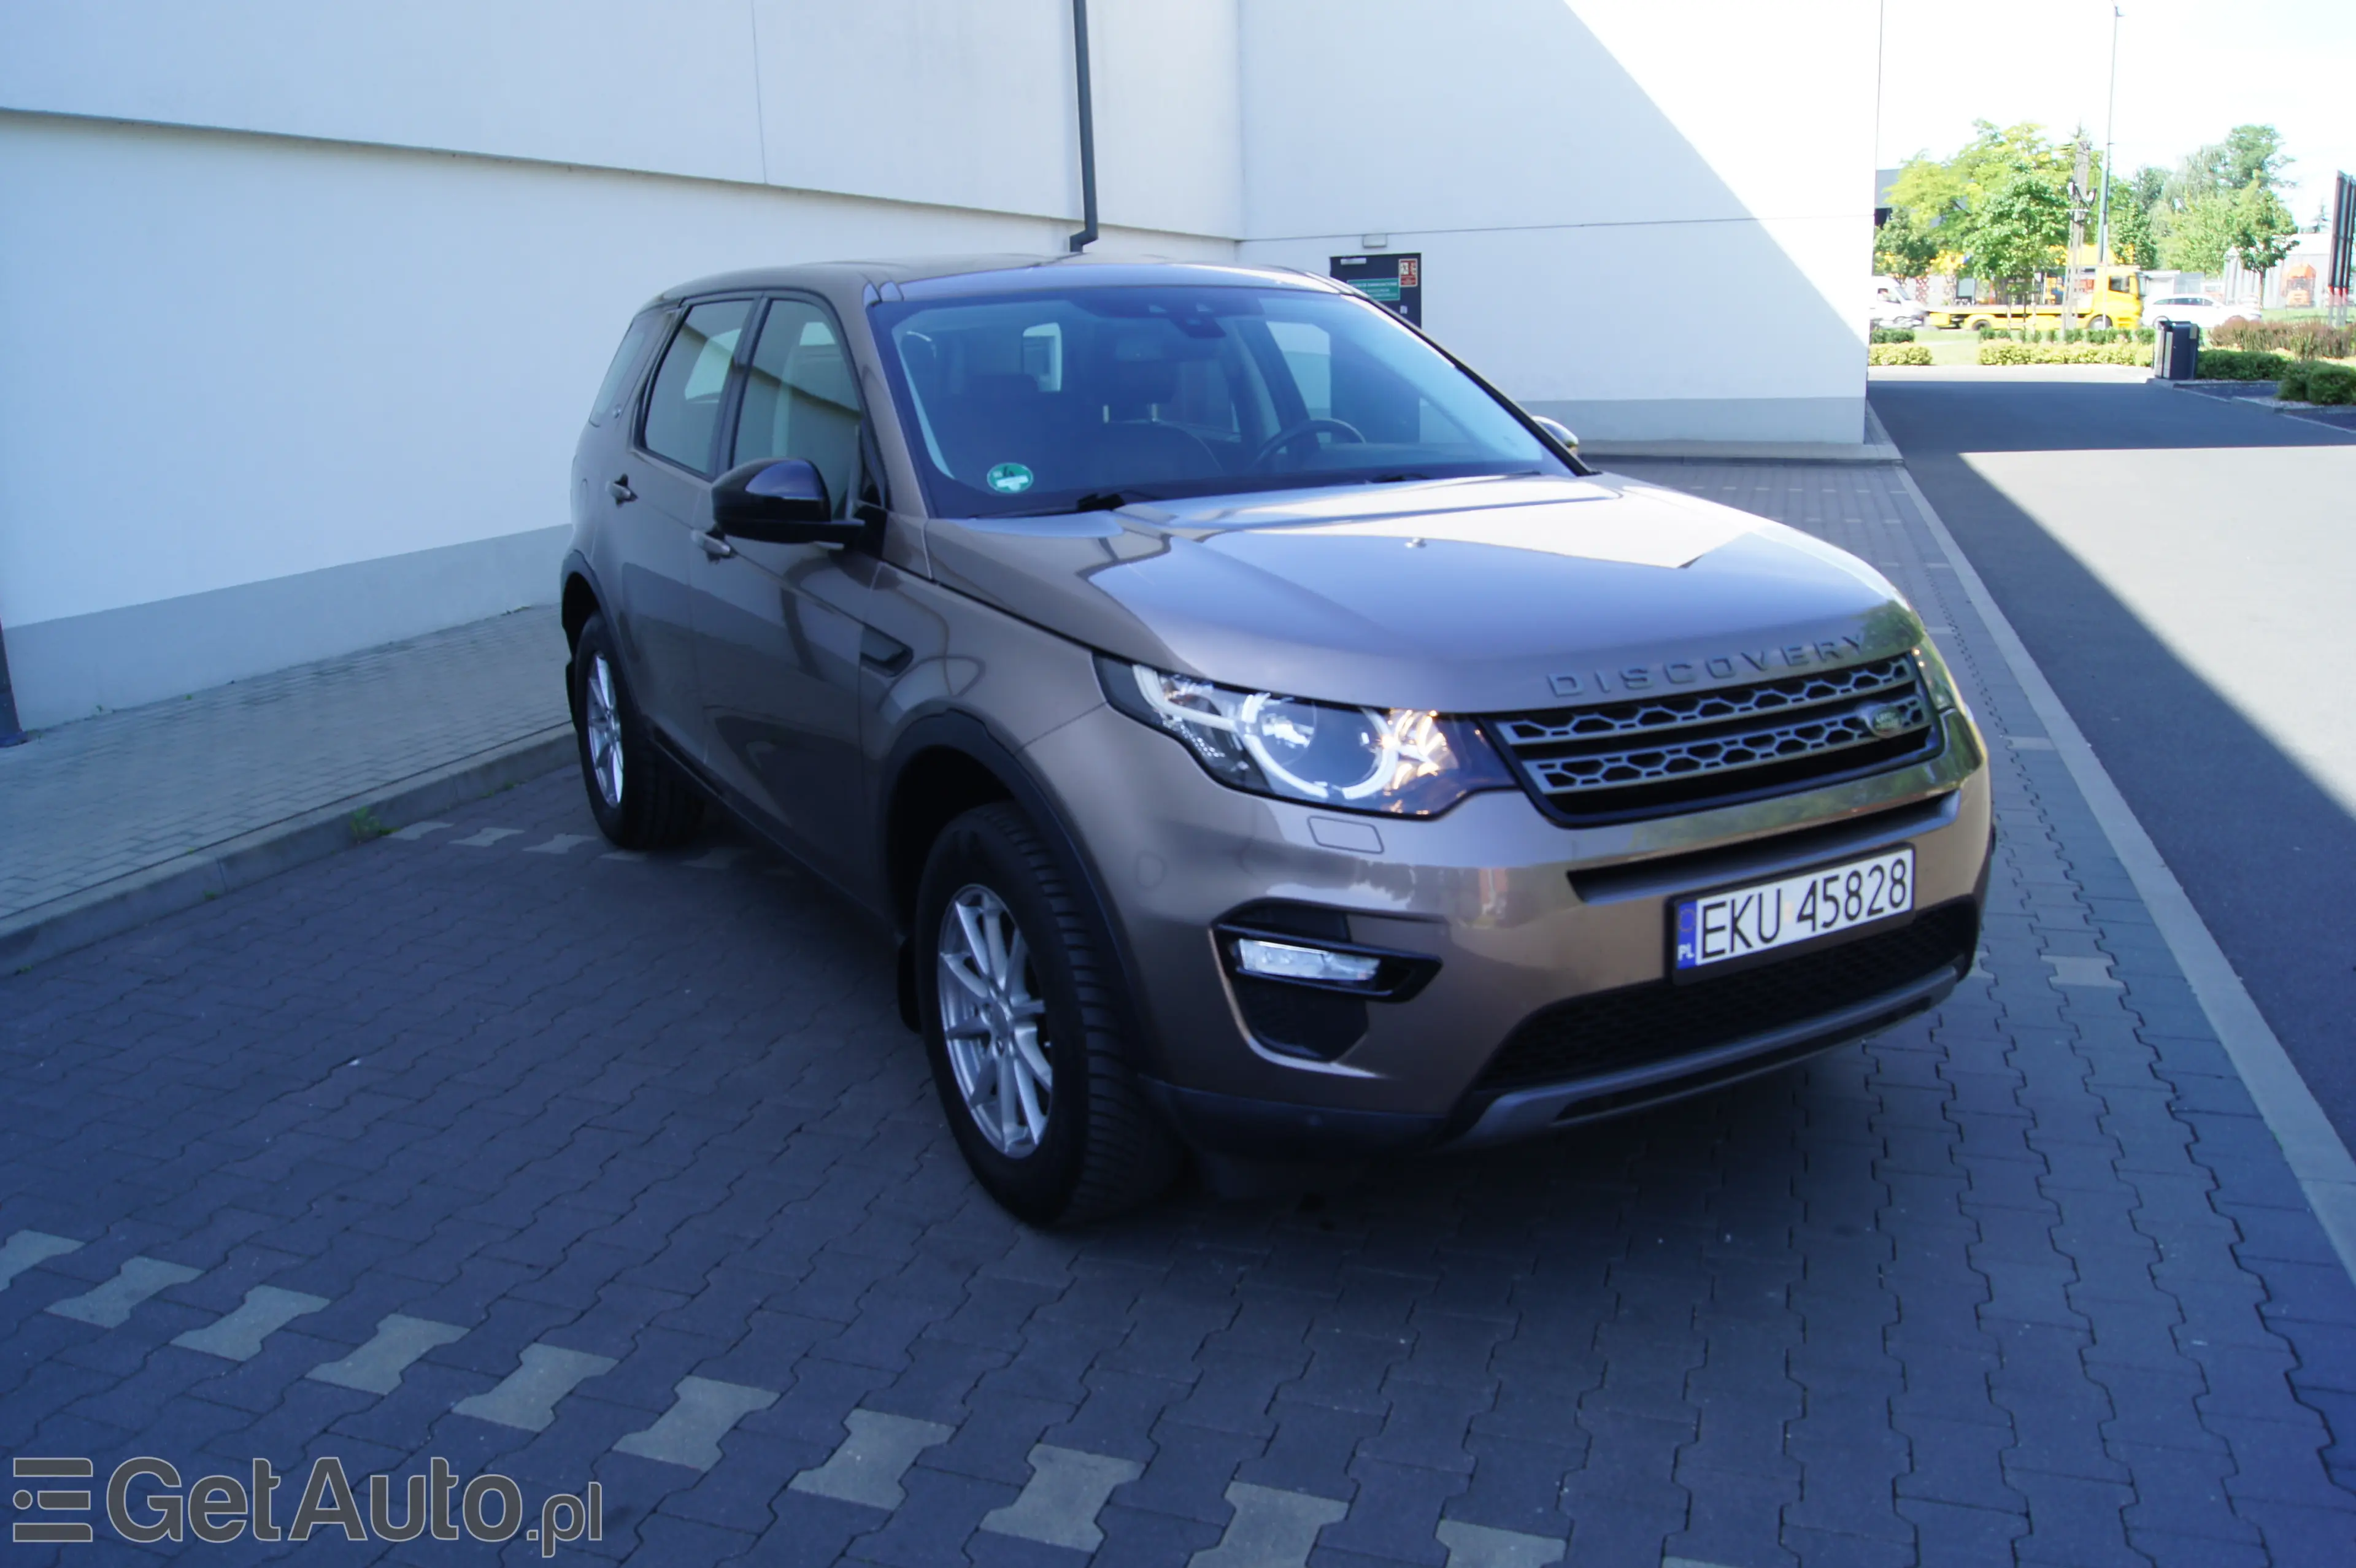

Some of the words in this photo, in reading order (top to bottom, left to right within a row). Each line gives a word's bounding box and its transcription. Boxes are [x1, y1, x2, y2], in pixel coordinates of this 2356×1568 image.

[1547, 635, 1863, 698] DISCOVERY
[1701, 888, 1781, 959] EKU
[1796, 858, 1906, 932] 45828
[1678, 943, 1695, 961] PL
